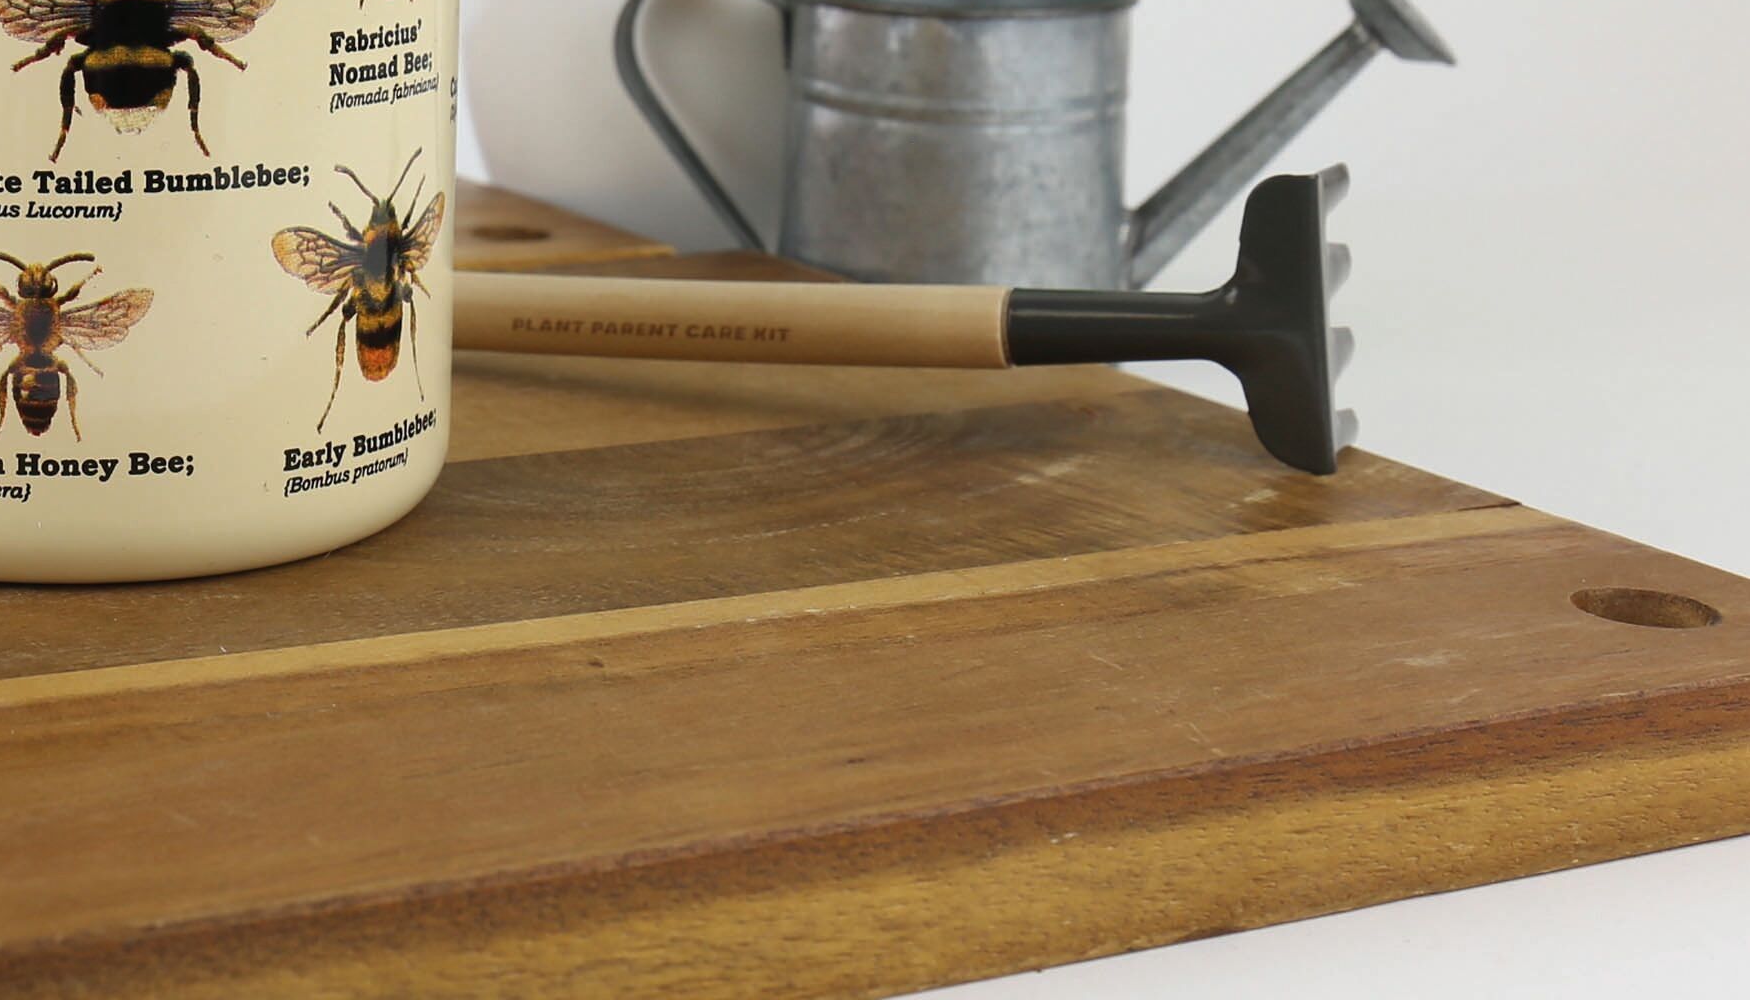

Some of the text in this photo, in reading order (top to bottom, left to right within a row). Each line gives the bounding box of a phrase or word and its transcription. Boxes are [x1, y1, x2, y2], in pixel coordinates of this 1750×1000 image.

[330, 18, 423, 55] Fabricius'
[329, 50, 433, 87] Nomad Bee;
[33, 171, 133, 194] Tailed
[143, 164, 310, 194] Bumblebee;
[511, 318, 790, 342] PLANT PARENT CARE KIT
[284, 408, 437, 472] Early Bumblebee;
[16, 453, 118, 481] Honey
[128, 452, 194, 476] Bee;
